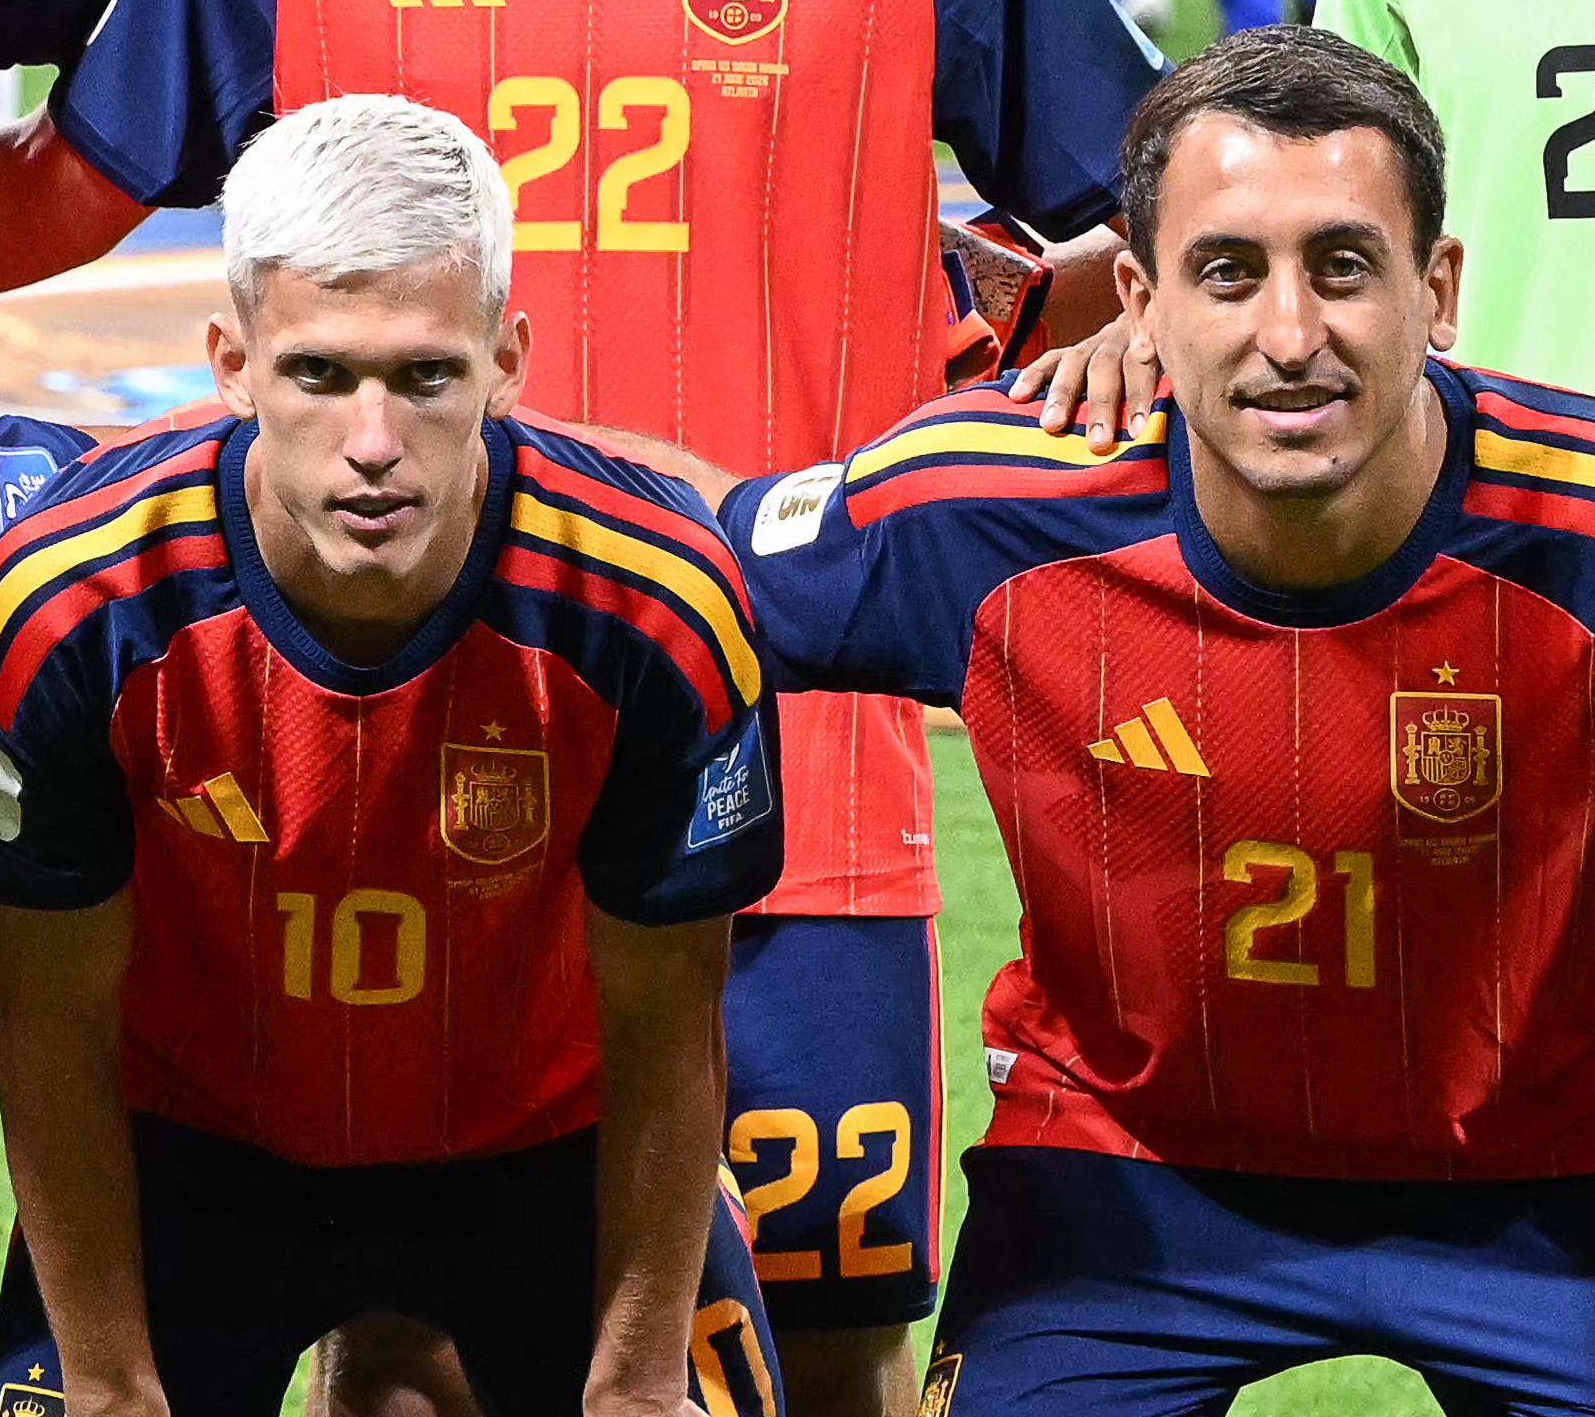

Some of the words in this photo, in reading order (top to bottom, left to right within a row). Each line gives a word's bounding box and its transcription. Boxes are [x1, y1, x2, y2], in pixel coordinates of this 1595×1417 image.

[487, 75, 691, 252] 22
[707, 784, 750, 820] PEACE
[718, 813, 744, 830] FIFA
[277, 889, 426, 1005] 10
[1223, 840, 1375, 987] 21
[730, 1101, 913, 1281] 22
